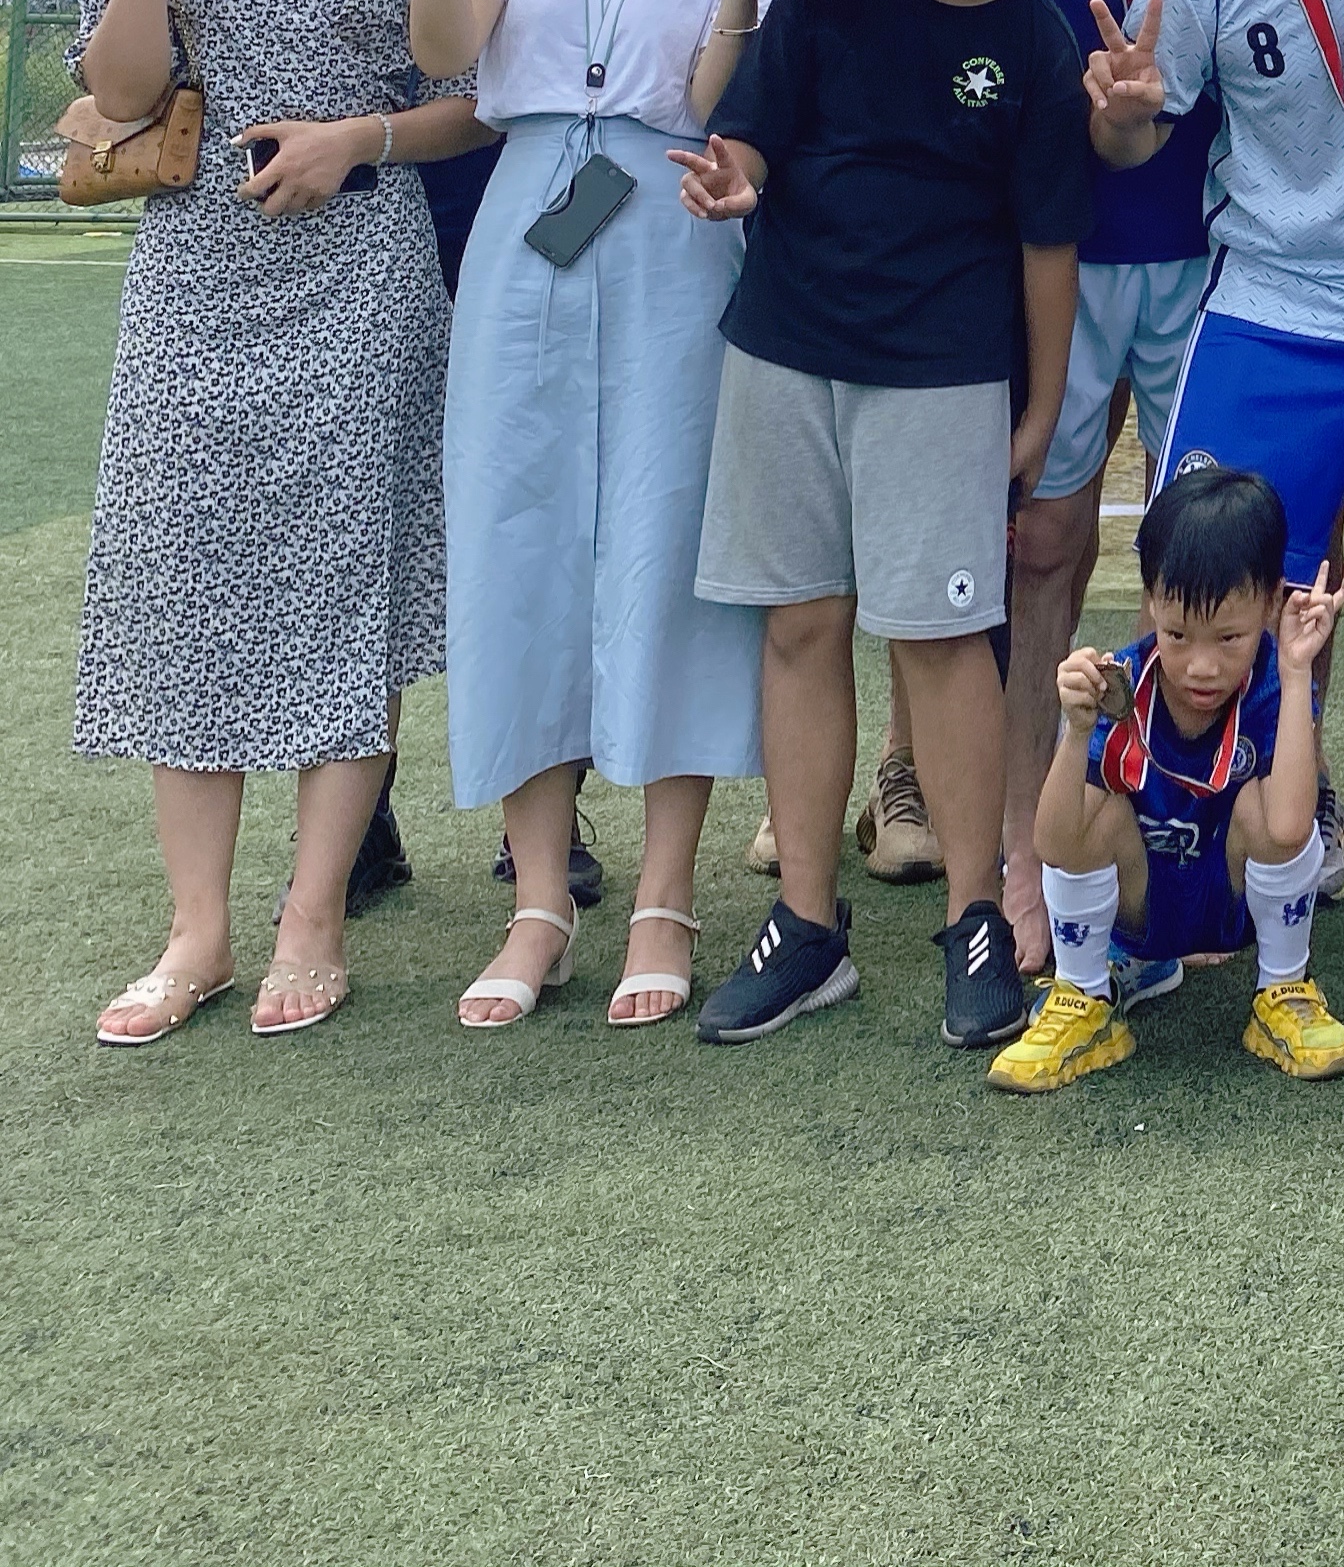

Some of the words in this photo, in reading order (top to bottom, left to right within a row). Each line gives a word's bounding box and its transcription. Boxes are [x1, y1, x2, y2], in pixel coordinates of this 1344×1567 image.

[1246, 22, 1286, 80] 8
[962, 57, 1005, 85] CONVERSE
[1054, 996, 1088, 1011] B.DUCK
[1271, 986, 1307, 1000] B.DUCK
